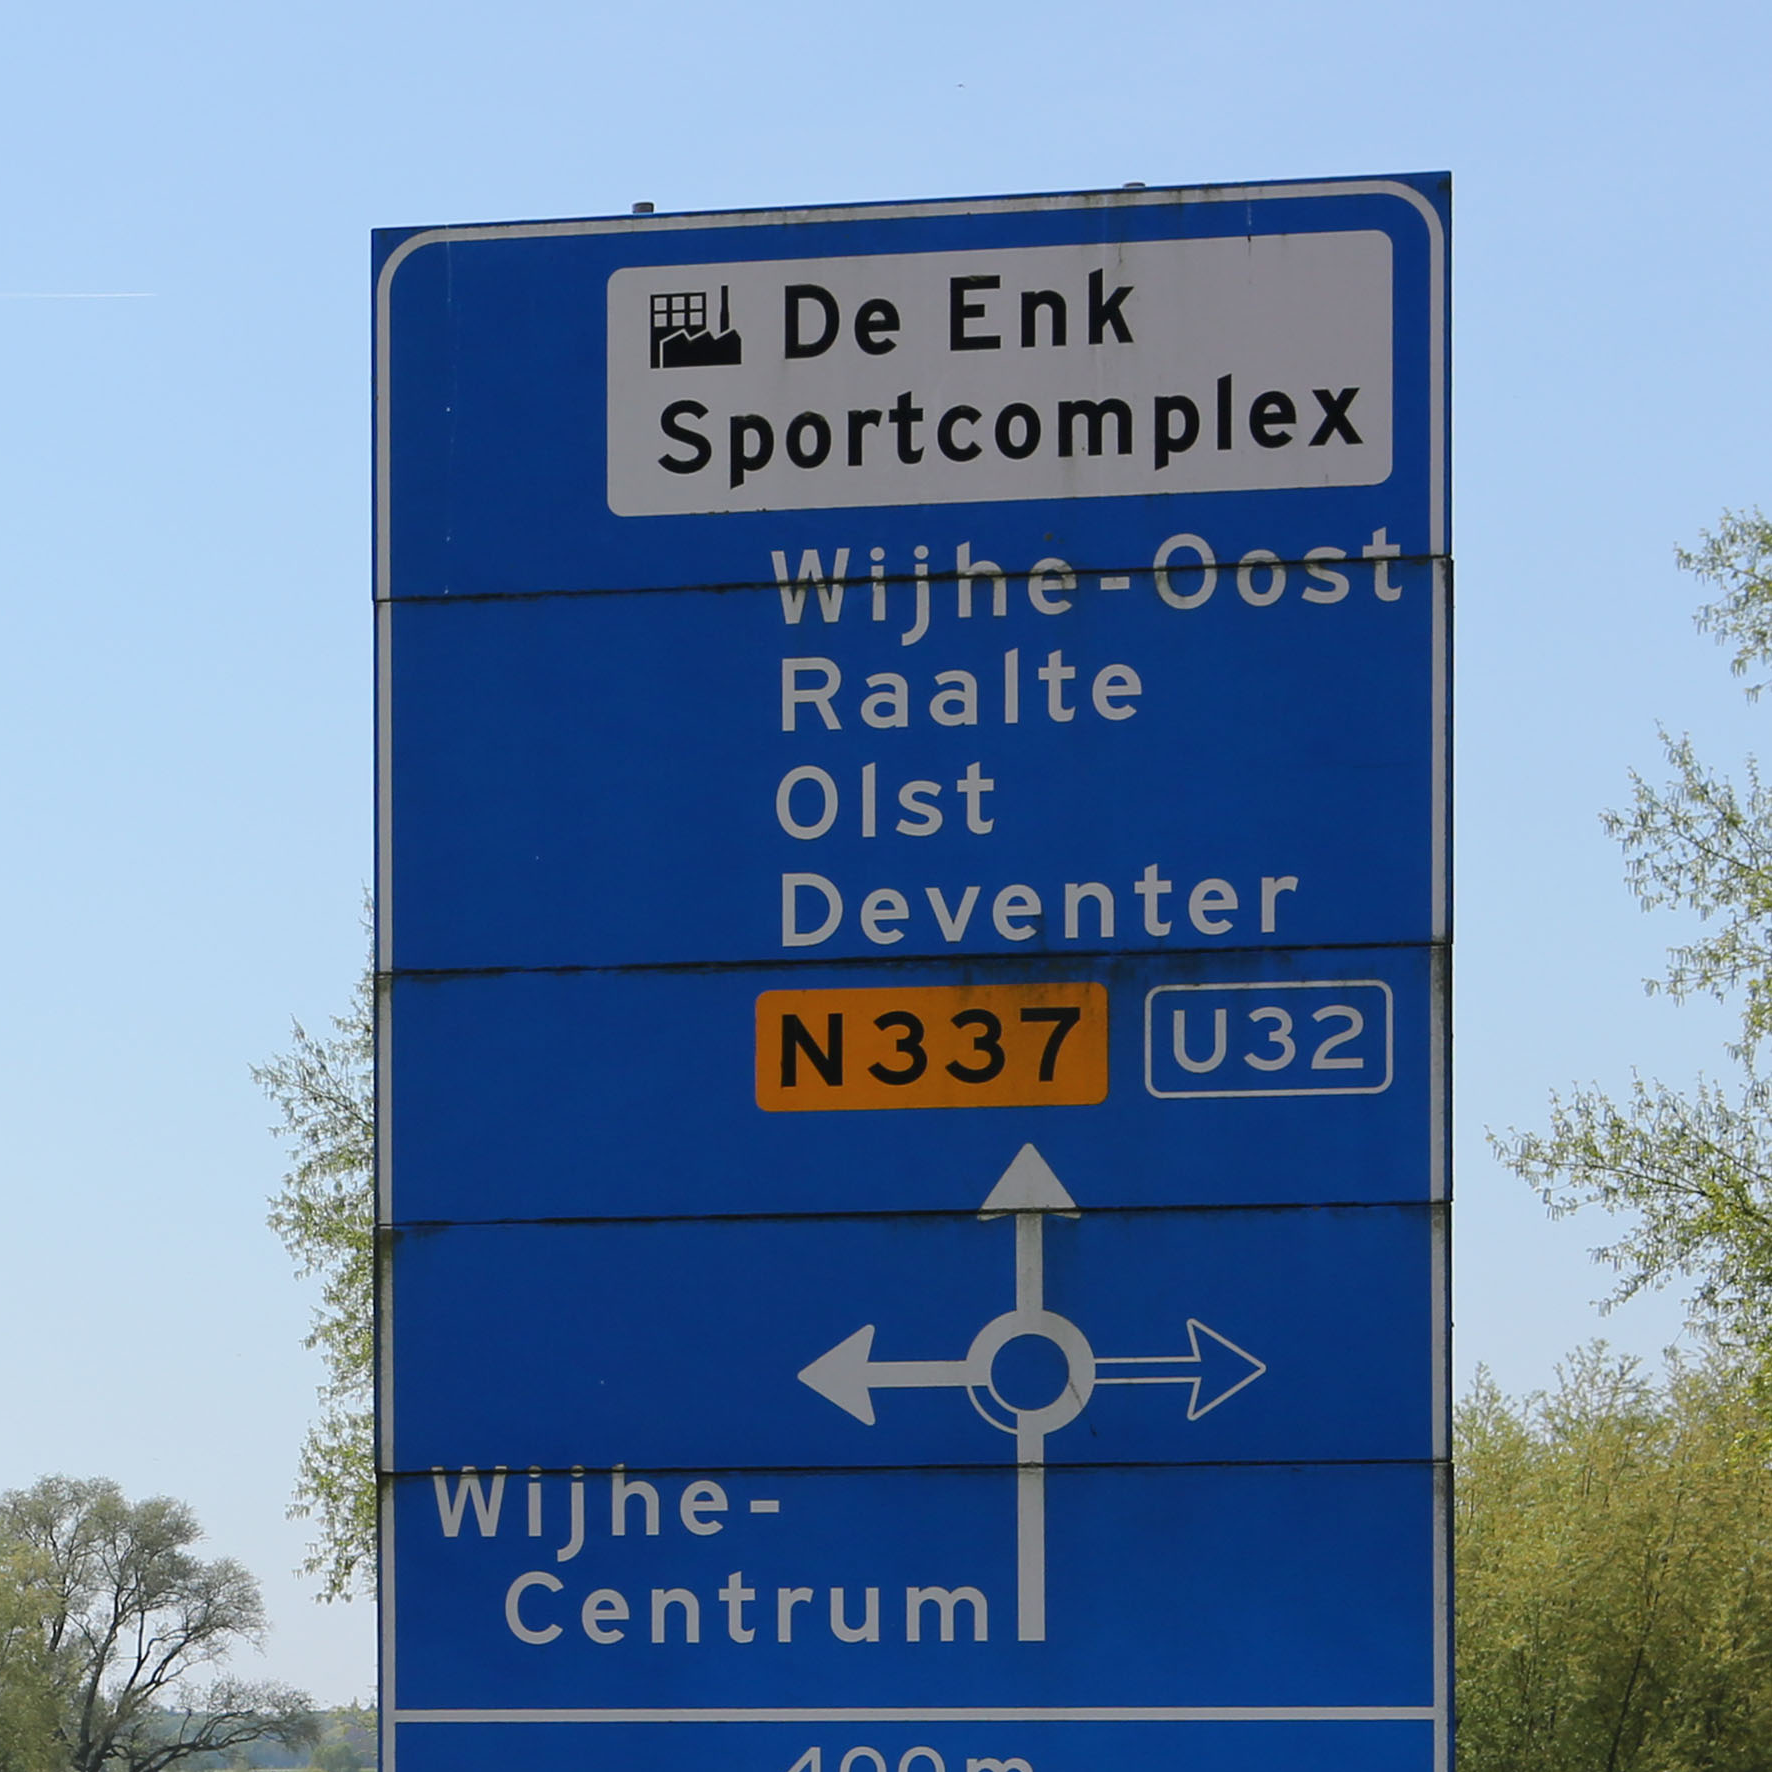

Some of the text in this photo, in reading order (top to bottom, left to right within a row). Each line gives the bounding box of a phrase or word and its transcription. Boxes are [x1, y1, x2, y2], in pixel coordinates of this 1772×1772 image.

[784, 267, 1136, 360] De Enk
[656, 373, 1364, 490] Sportcomplex
[771, 527, 1403, 646] Wijhe-Oost
[781, 647, 1143, 732] Raalte
[776, 761, 995, 841] Olst
[782, 863, 1300, 948] Deventer
[779, 1005, 1084, 1089] N337
[1173, 1004, 1365, 1074] U32
[432, 1464, 781, 1563] Wijhe-
[504, 1571, 989, 1645] Centrum
